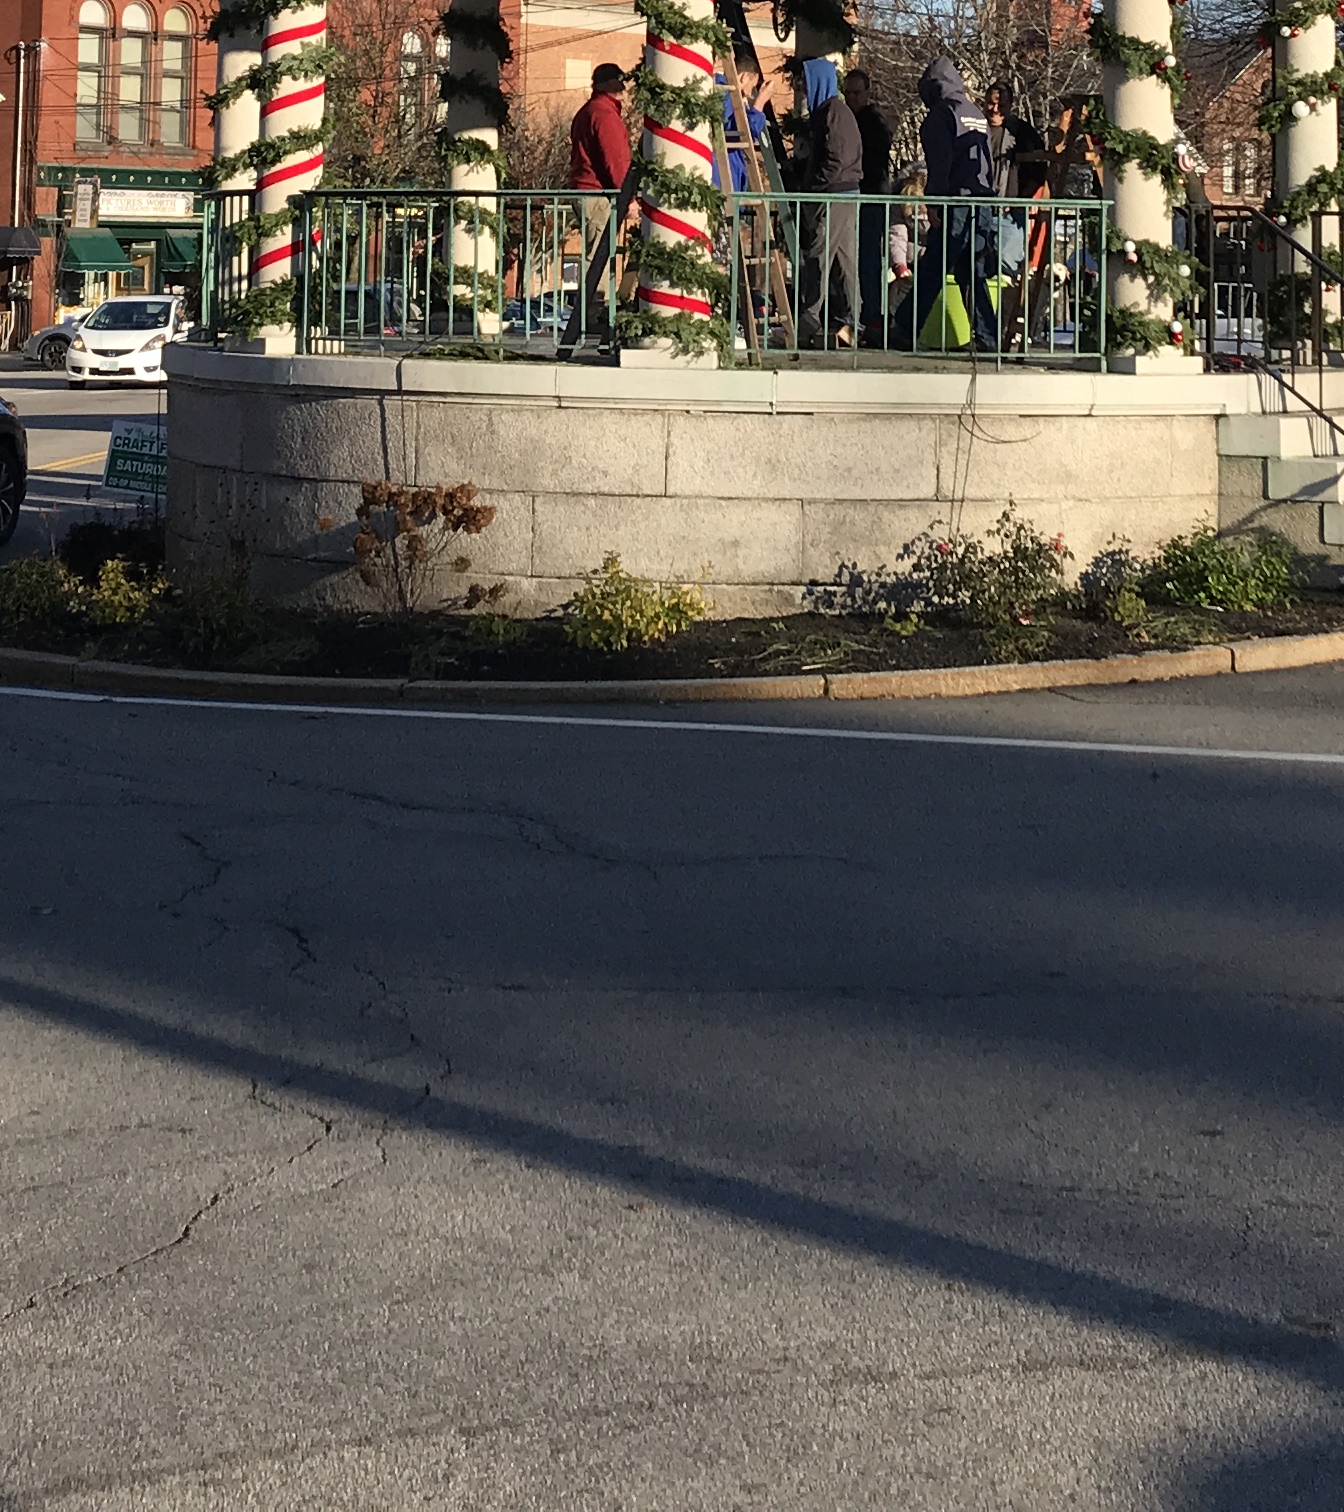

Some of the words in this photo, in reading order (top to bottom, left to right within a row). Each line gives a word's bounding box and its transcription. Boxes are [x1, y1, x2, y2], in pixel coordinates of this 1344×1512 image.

[101, 197, 143, 206] PICTURES
[146, 199, 176, 207] WORTH
[113, 435, 156, 453] CRAFT
[116, 458, 168, 476] SATURDA
